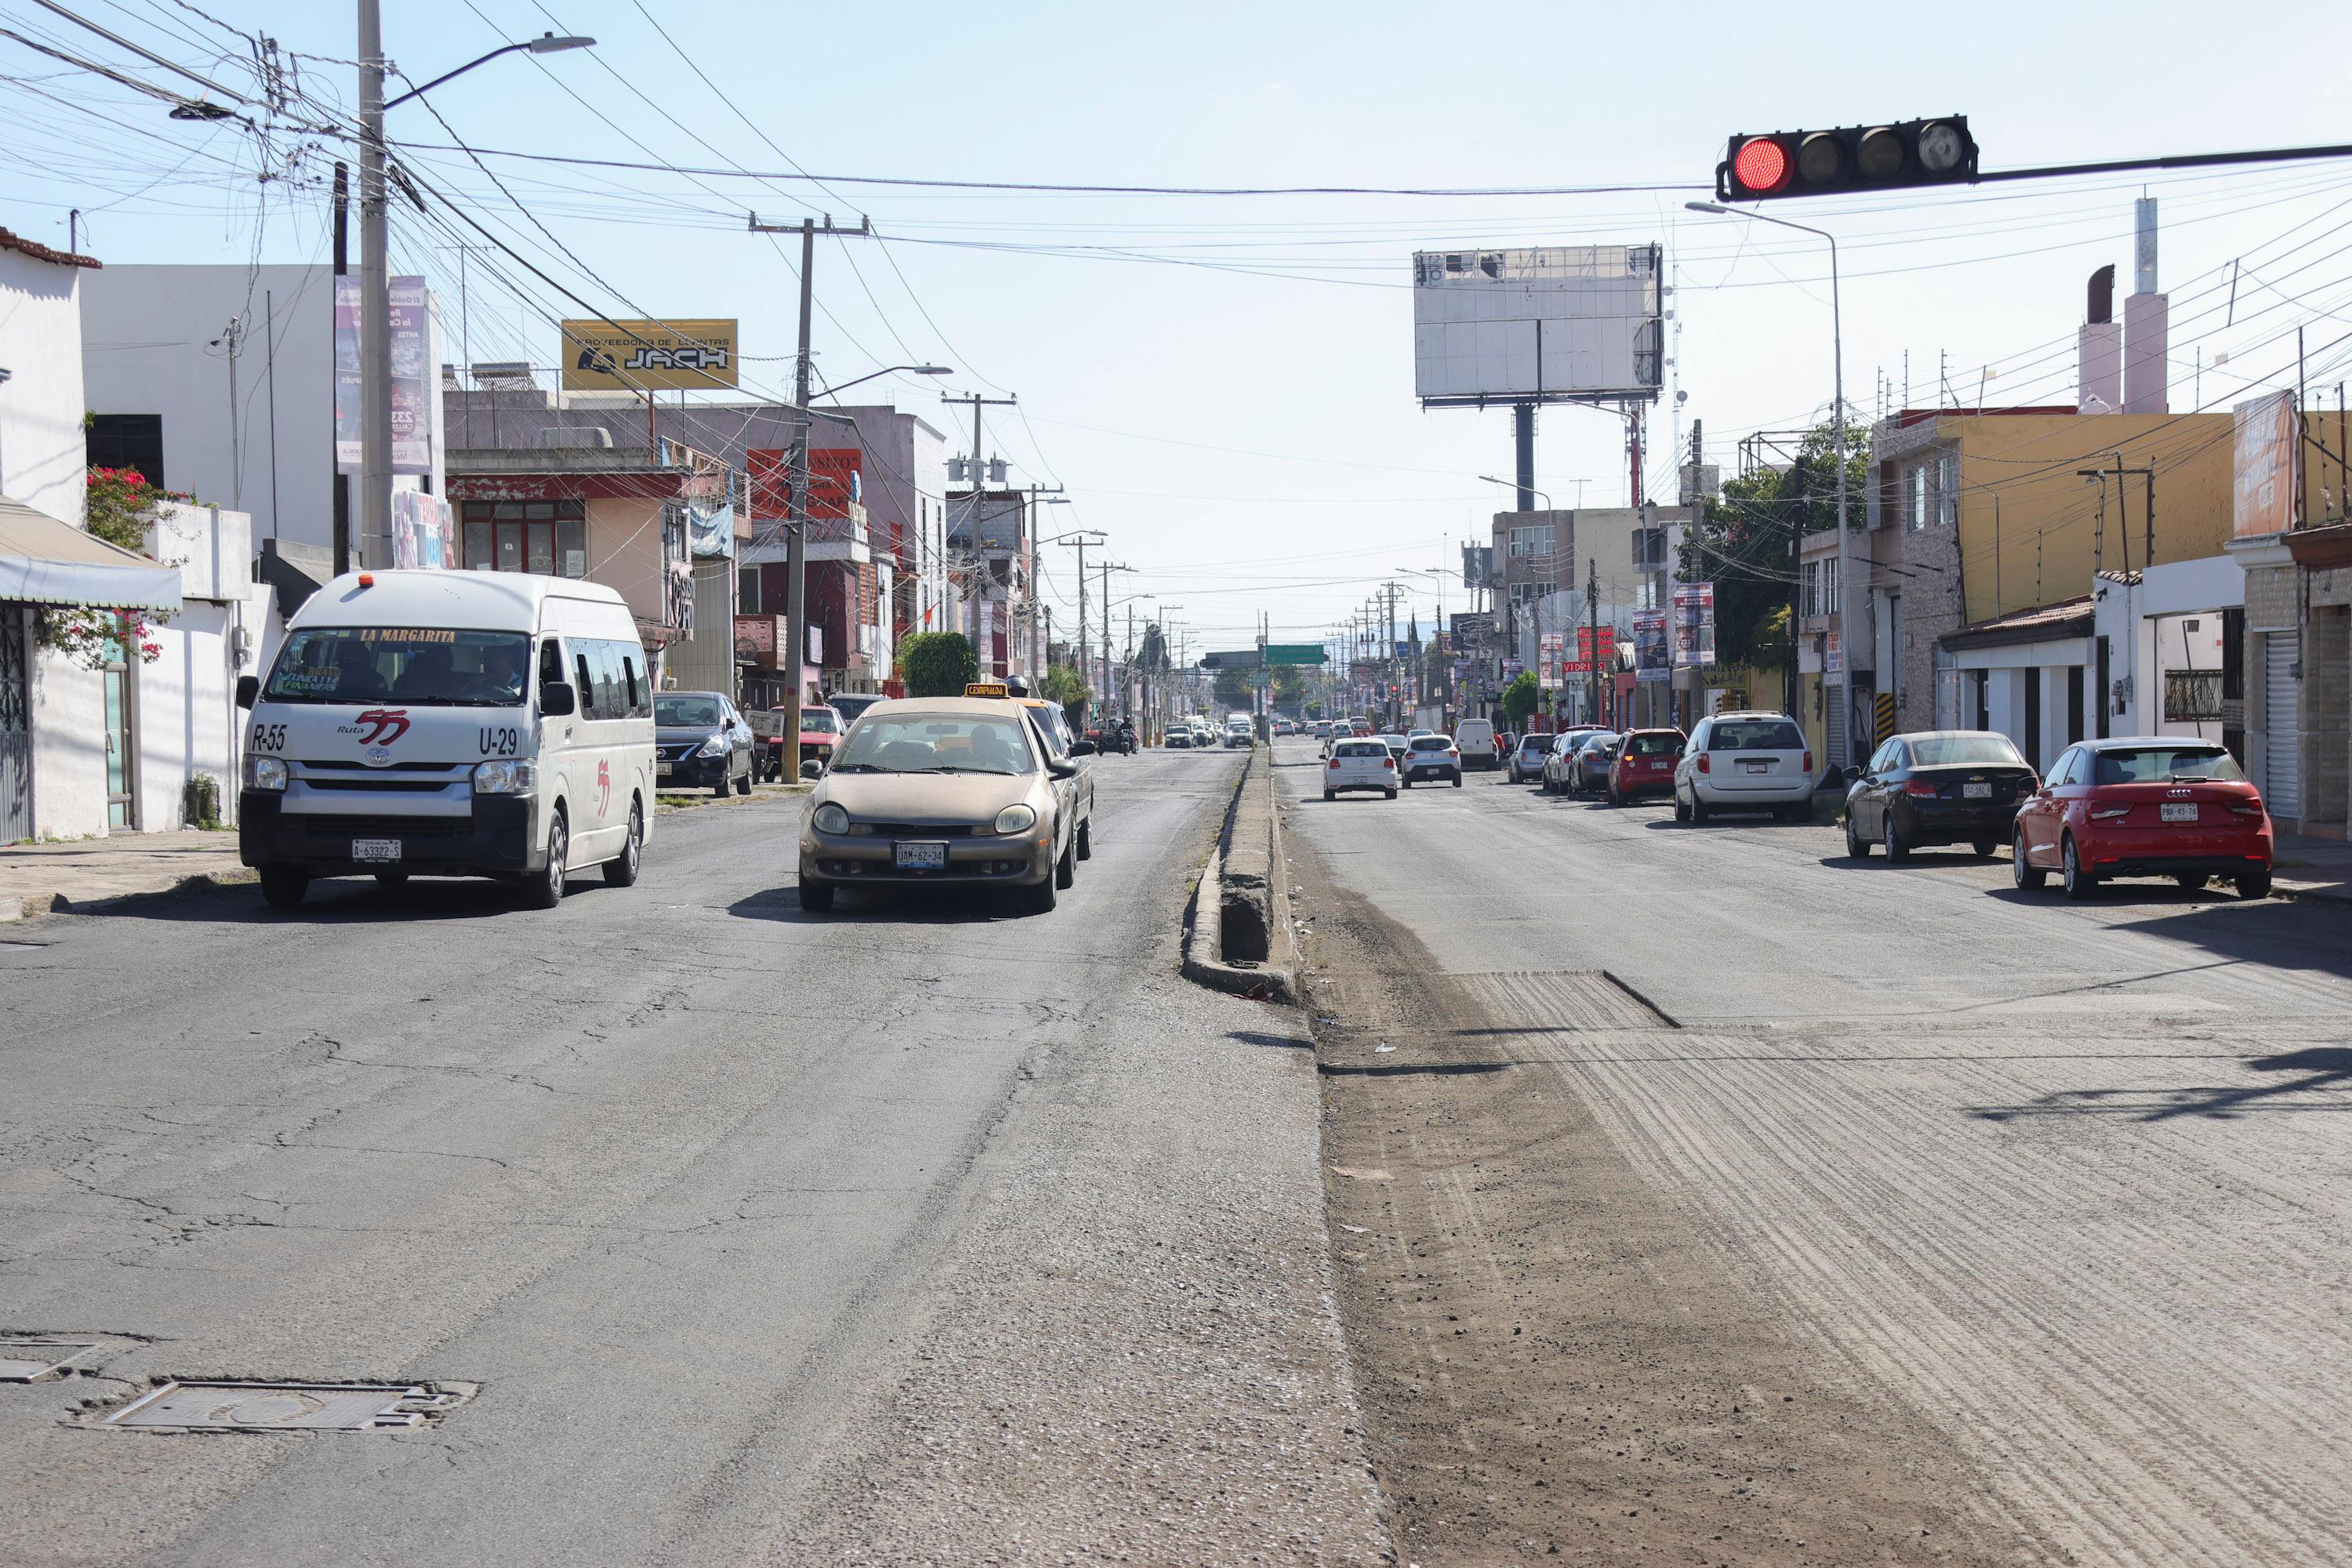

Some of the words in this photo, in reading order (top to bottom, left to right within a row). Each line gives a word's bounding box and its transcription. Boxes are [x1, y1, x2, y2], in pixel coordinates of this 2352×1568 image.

[624, 347, 728, 370] JACH
[360, 630, 376, 641] LA
[379, 630, 456, 643] MARGARITA
[1563, 662, 1604, 671] VIDRIS
[336, 725, 365, 735] Ruta
[355, 709, 411, 746] 55
[252, 724, 288, 752] R-55
[479, 728, 517, 756] U-29
[354, 846, 400, 856] A-63322-S
[898, 851, 942, 861] UAM-62-34
